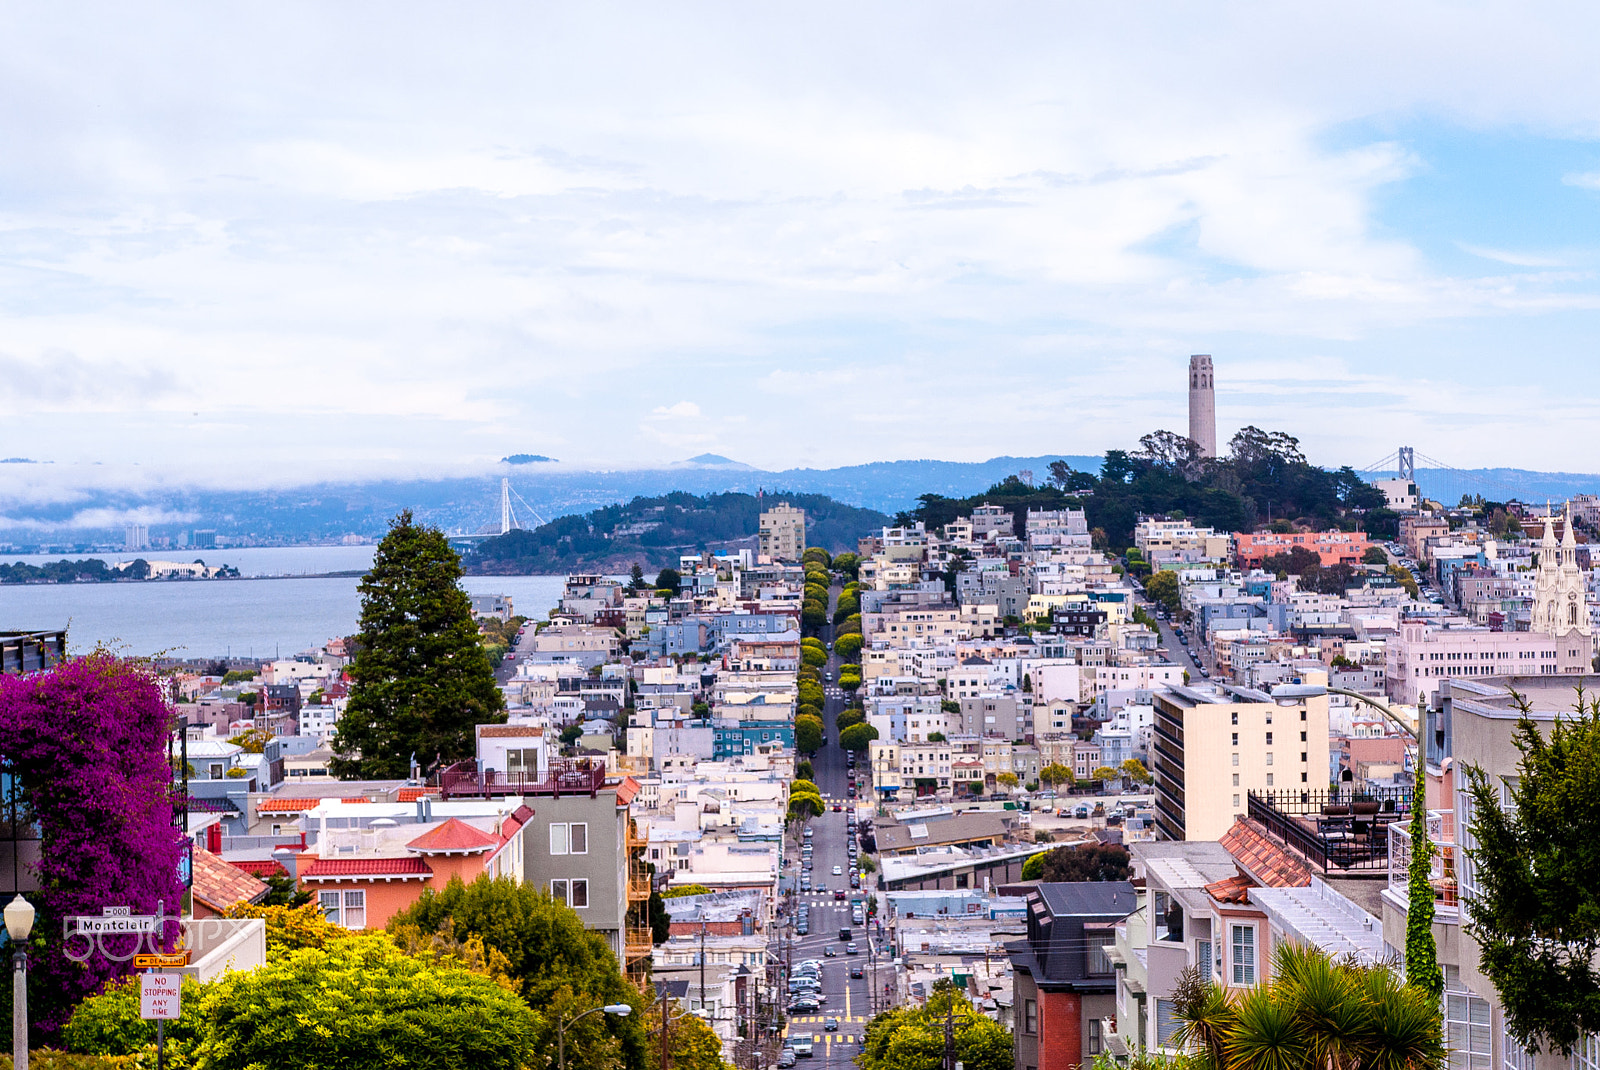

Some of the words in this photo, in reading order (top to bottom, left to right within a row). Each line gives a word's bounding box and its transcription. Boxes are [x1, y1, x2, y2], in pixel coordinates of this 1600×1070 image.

[84, 920, 149, 930] Montclair
[154, 977, 167, 985] NO
[144, 988, 177, 996] STOPPING
